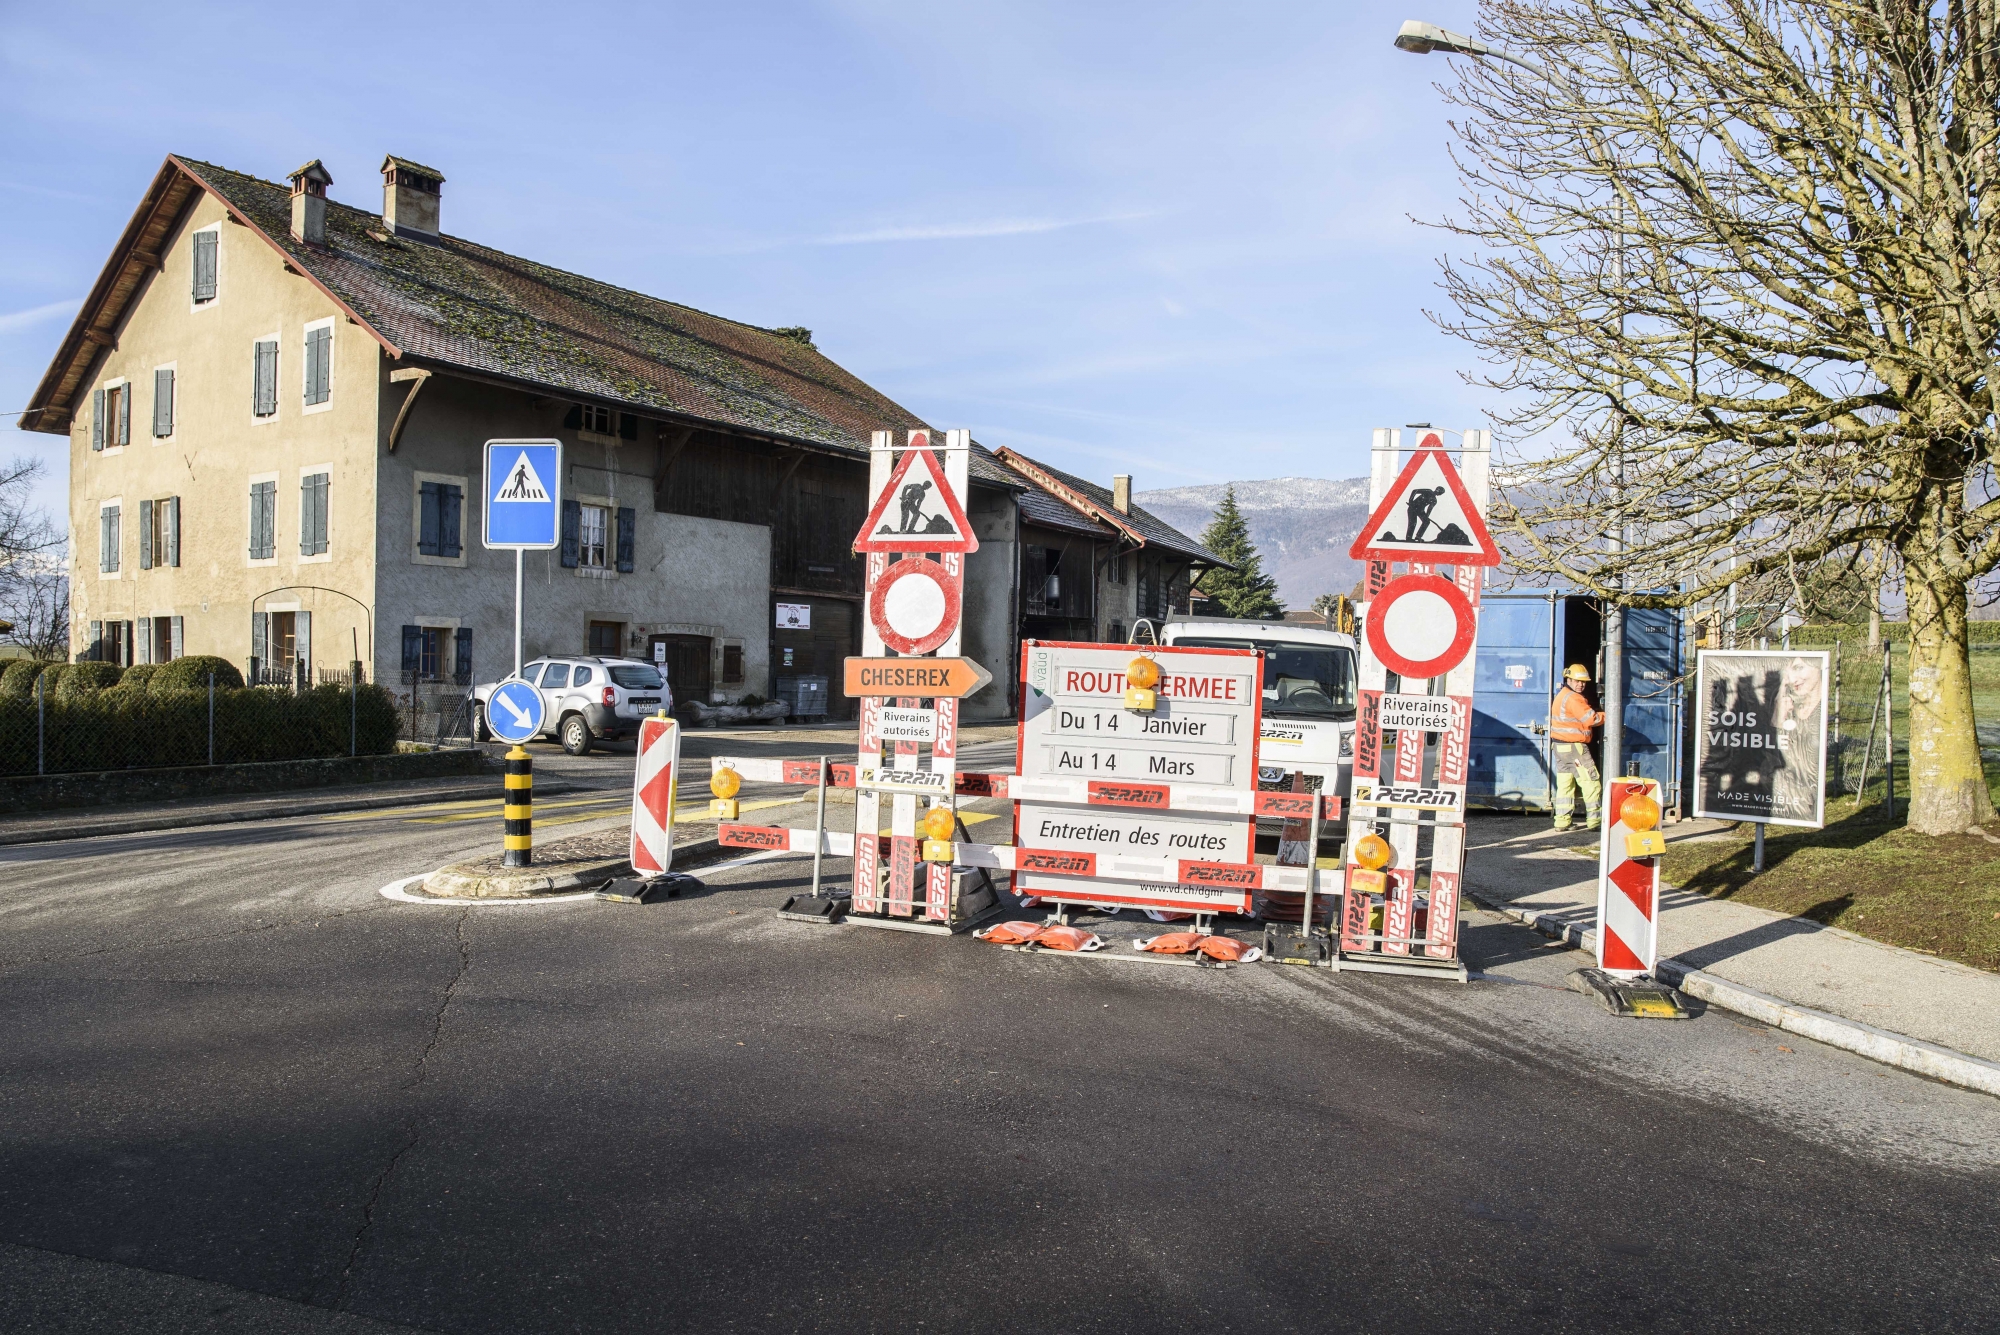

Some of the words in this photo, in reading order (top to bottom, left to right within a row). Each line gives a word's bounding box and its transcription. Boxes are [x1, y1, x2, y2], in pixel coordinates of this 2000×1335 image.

[1036, 652, 1048, 682] vaud
[860, 668, 950, 687] CHESEREX
[1153, 676, 1237, 700] ERMEE
[1384, 698, 1448, 713] Riverains
[884, 712, 930, 723] Riverains
[1060, 712, 1085, 730] Du
[1142, 715, 1207, 736] Janvier
[1382, 714, 1448, 728] autorisés
[1708, 711, 1757, 728] SOIS
[883, 726, 930, 737] autorisés
[1707, 731, 1790, 750] VISIBLE
[1059, 751, 1083, 769] Au
[1150, 756, 1194, 776] Mars
[1717, 791, 1750, 800] MADE
[1754, 794, 1800, 805] VISIBLE
[1040, 820, 1120, 843] Entretien
[1128, 827, 1160, 846] des
[1168, 832, 1226, 850] routes
[1140, 882, 1224, 898] www.vd.ch/dgmr
